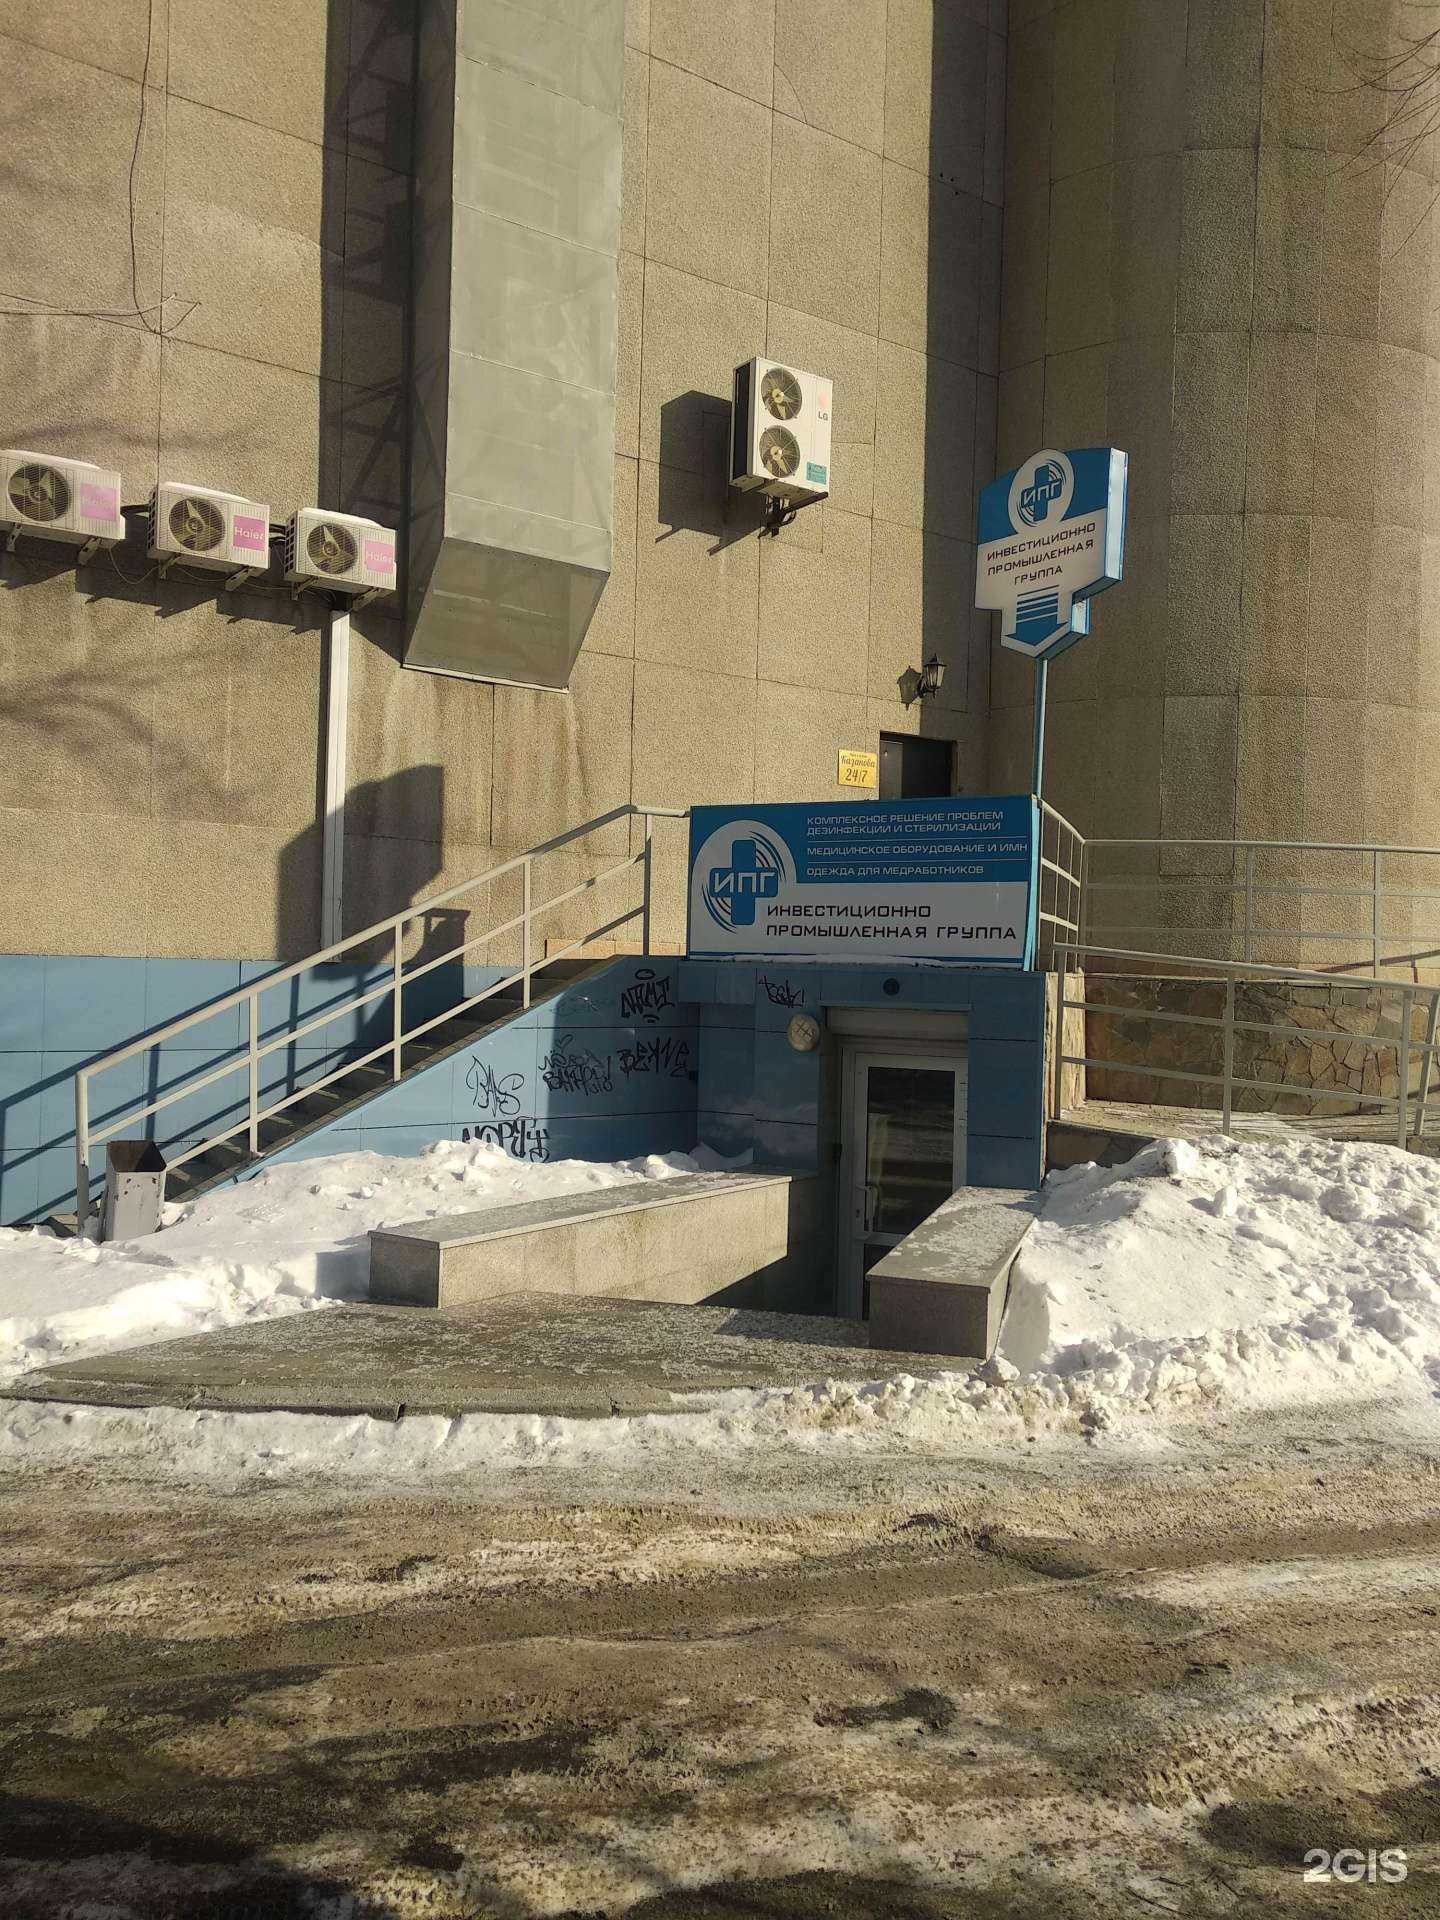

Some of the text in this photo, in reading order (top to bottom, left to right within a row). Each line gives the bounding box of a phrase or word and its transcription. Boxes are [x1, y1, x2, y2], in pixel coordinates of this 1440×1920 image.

[817, 410, 829, 422] LG
[1023, 481, 1061, 505] ИПГ
[234, 526, 265, 540] Haier
[986, 522, 1096, 561] ИНВЕСТИЦИОННО
[987, 539, 1094, 576] ПРОМЫШЛЕННАЯ
[1014, 565, 1063, 585] ГРУППА
[845, 768, 868, 784] 24/7
[807, 811, 1003, 825] КОМПЛЕКСНОЕ РЕШЕНИЕ ПРОБЛЕМ
[807, 821, 1001, 836] ДЕЗИНФЕКЦИИ И СТЕРИЛИЗАЦИИ
[807, 843, 1027, 856] МЕДИЦИНСКОЕ ОБОРУДОВАНИЕ И ИМН
[807, 865, 984, 877] ОДЕЖДА ДЛЯ МЕДРАБОТНИКОВ
[713, 871, 776, 894] ИПГ
[767, 905, 931, 919] ИНВЕСТИЦИОННО
[766, 924, 1017, 940] ПРОМЫШЛЕННАЯ ГРУППА
